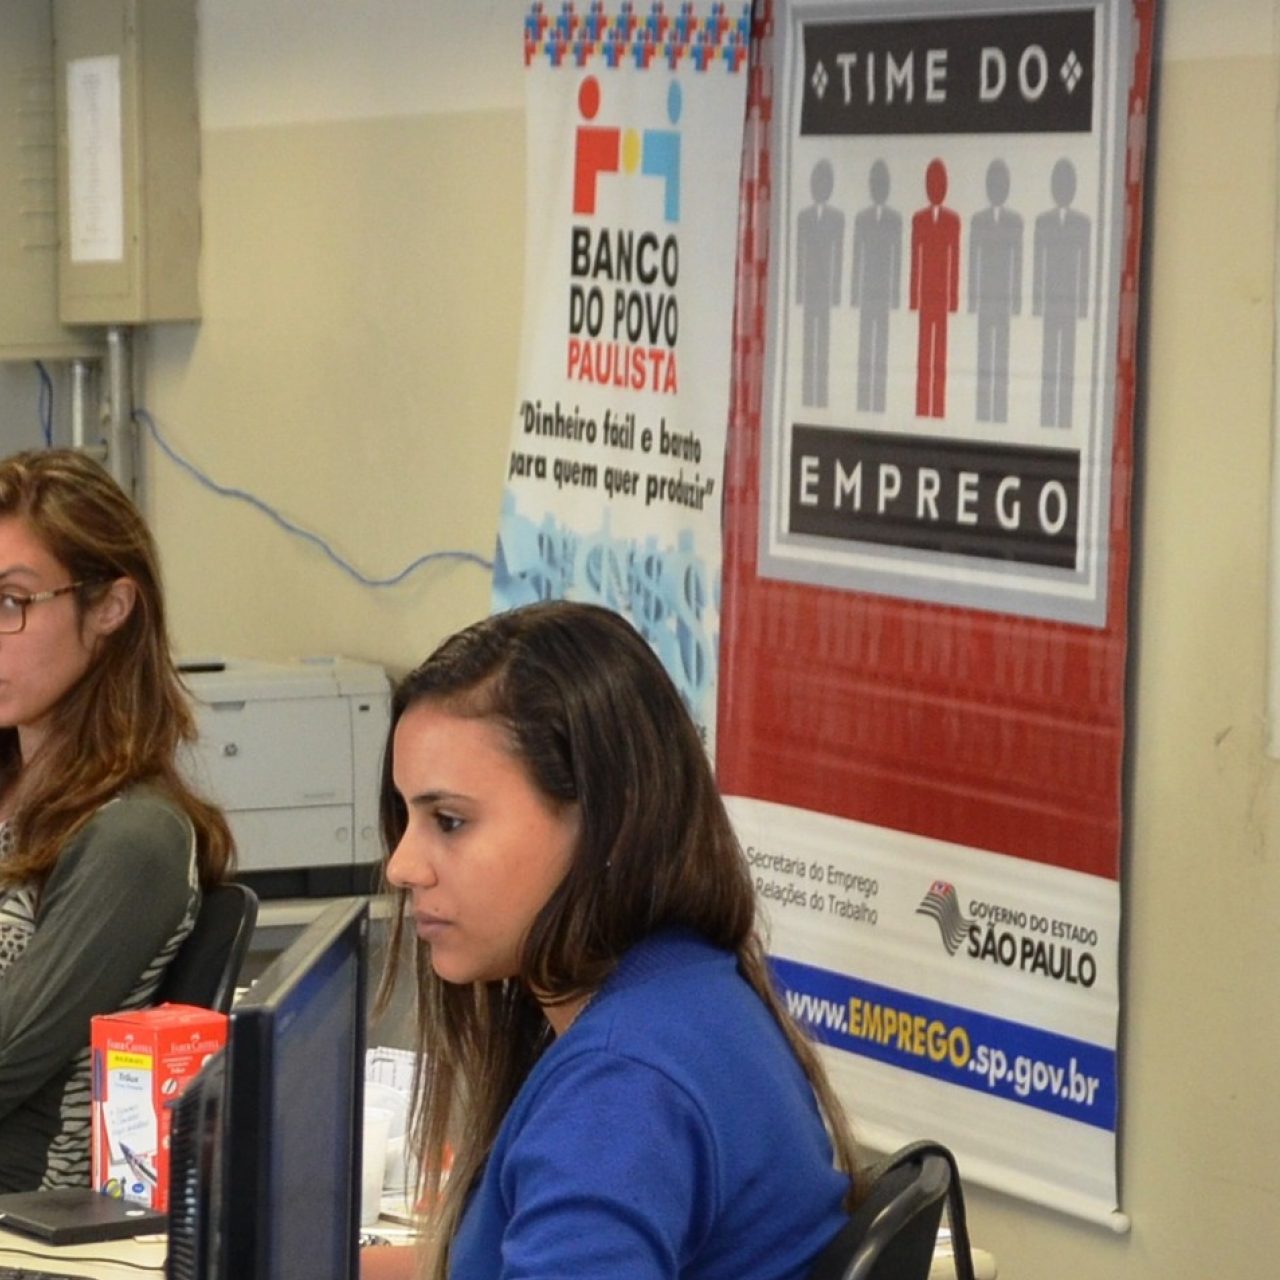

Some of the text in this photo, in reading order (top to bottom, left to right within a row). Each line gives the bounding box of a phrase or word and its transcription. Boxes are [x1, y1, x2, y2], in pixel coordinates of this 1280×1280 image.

[836, 44, 1049, 105] TIME DO
[570, 225, 679, 288] BANCO
[569, 283, 678, 348] DO POVO
[567, 337, 677, 396] PAULISTA
[603, 408, 635, 450] fácil
[640, 426, 653, 453] e
[660, 417, 702, 464] barato
[508, 451, 547, 480] para
[553, 456, 598, 490] quem
[604, 465, 640, 498] quer
[800, 455, 1069, 536] EMPREGO
[747, 846, 879, 898] Secretaria do Emprego
[756, 877, 878, 925] Relações do Trabalho
[970, 900, 1097, 946] GOVERNO DO ESTADO
[968, 922, 1097, 987] SÃO PAULO
[786, 989, 1100, 1106] www.EMPREGO.sp.gov.br
